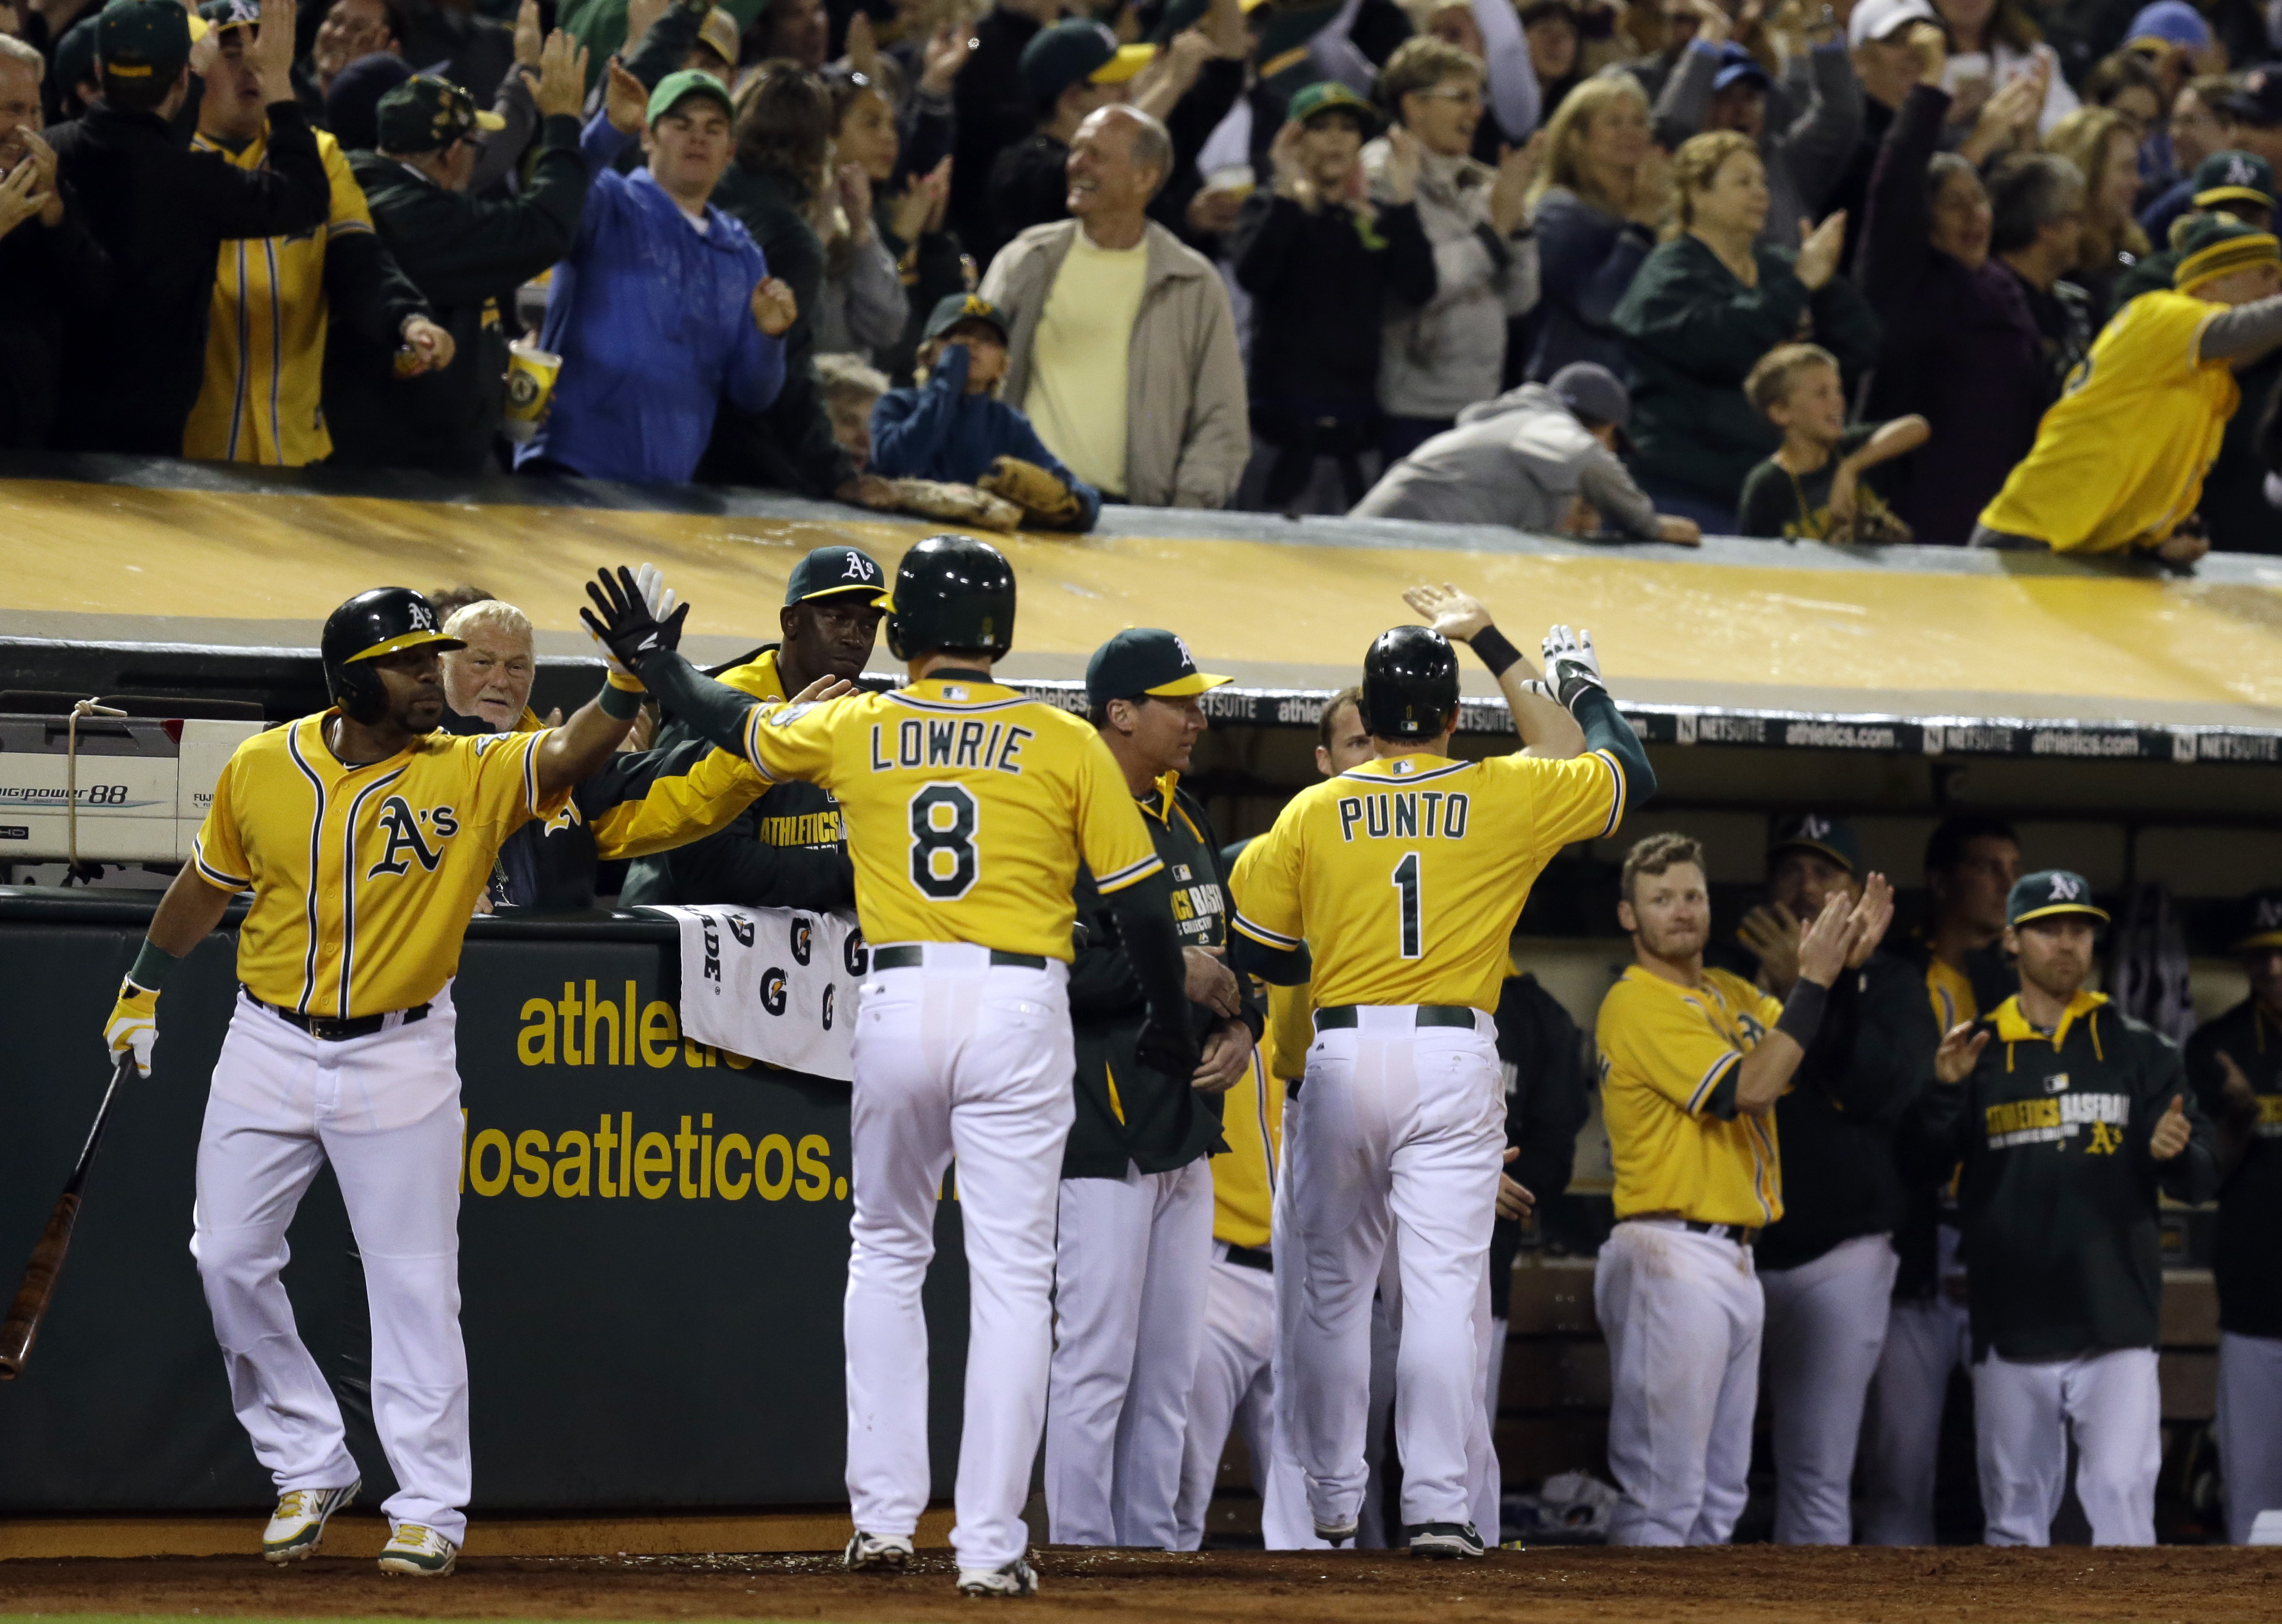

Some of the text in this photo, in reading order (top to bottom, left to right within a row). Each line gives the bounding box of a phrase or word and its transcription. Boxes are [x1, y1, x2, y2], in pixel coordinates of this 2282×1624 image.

[841, 551, 874, 581] A's
[408, 602, 432, 630] A's
[871, 718, 1035, 775] LOWRIE
[88, 785, 128, 804] 88
[1338, 791, 1470, 843] PUNTO
[366, 795, 459, 882] A's
[759, 811, 840, 847] ATHLETICS
[908, 781, 979, 902] 8
[1390, 850, 1423, 960] 1
[761, 967, 787, 1016] G
